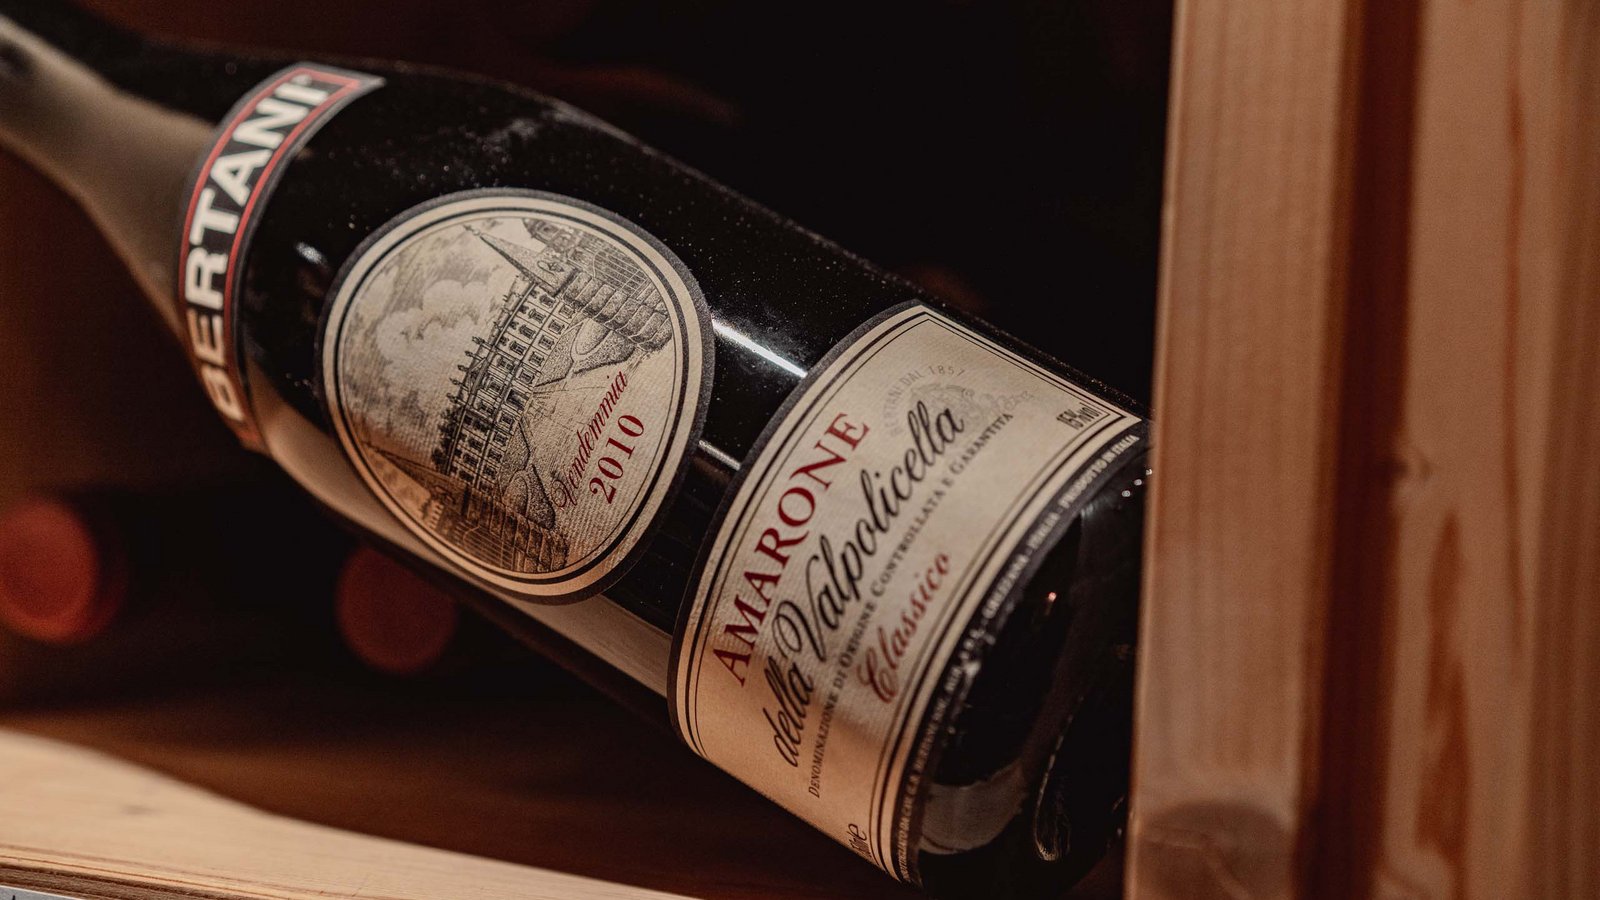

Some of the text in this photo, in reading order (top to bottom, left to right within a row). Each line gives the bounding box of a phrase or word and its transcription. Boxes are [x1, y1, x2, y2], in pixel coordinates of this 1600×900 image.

[184, 76, 331, 422] BERTANI
[551, 370, 628, 508] Vendemmia
[928, 364, 965, 377] 1857
[588, 414, 645, 504] 2010
[713, 412, 870, 687] AMARONE
[763, 400, 965, 768] della Valpolicella
[856, 553, 950, 704] Classico
